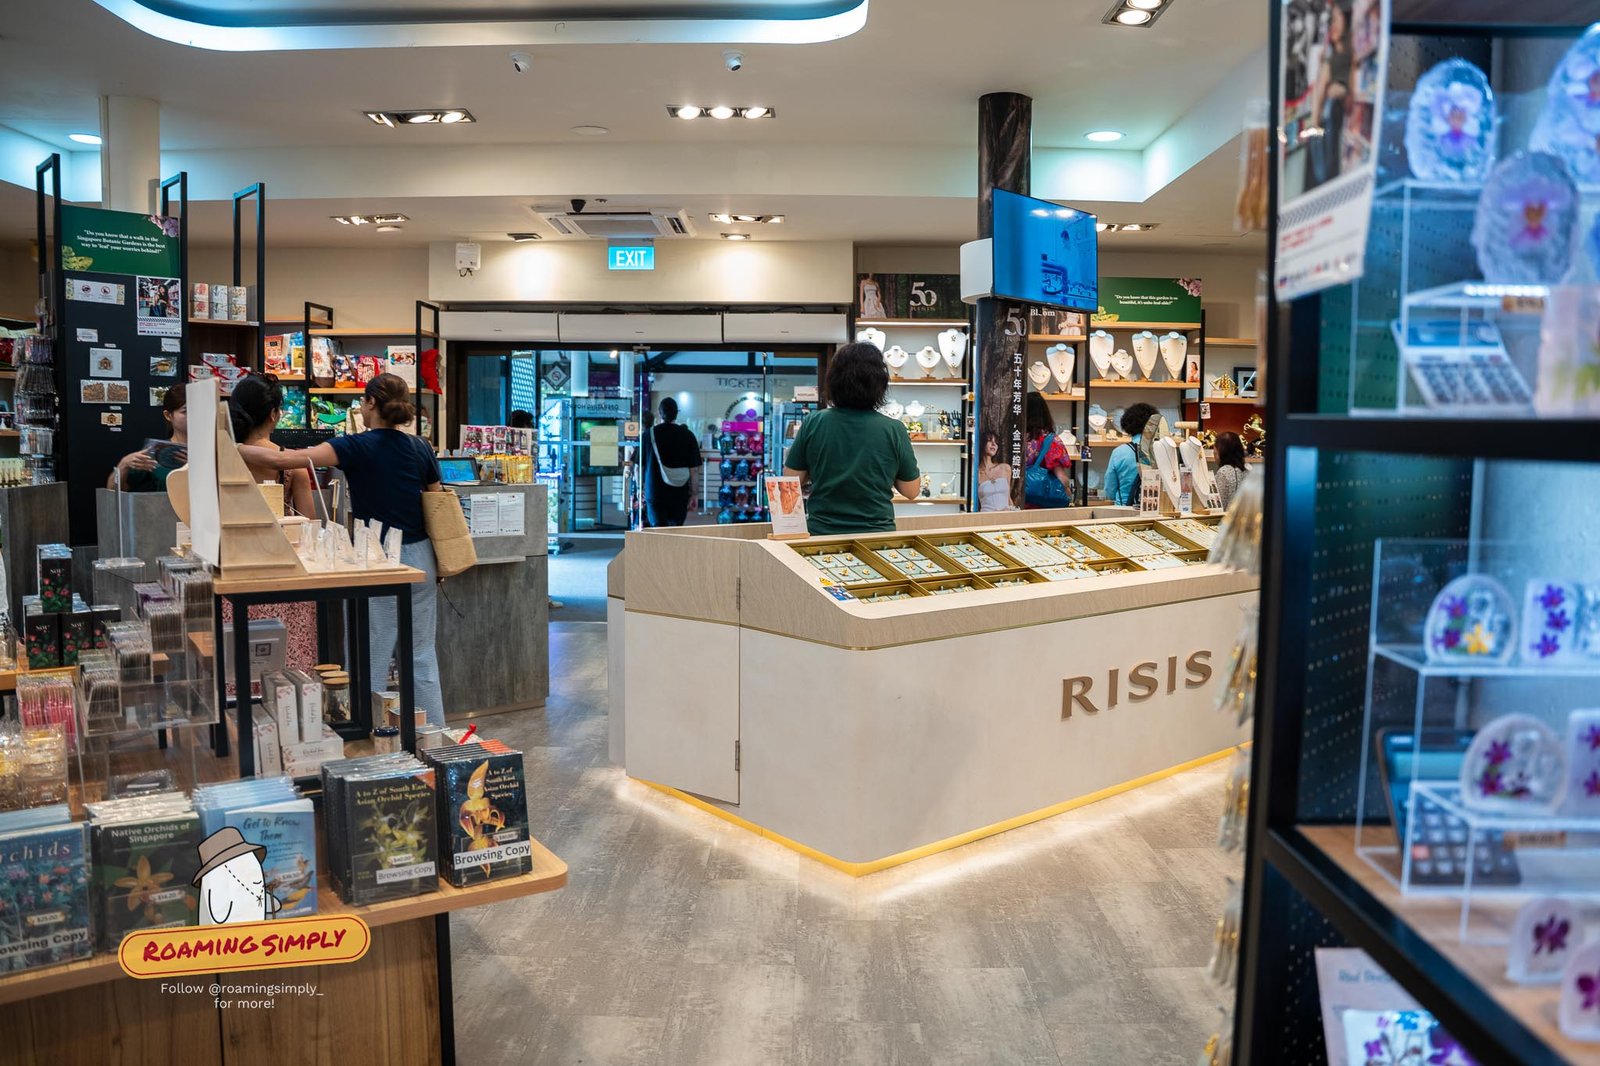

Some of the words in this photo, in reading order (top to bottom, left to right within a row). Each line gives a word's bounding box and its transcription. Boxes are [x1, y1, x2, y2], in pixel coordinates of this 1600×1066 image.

[76, 235, 102, 243] Singapore
[615, 250, 647, 267] EXIT
[910, 281, 937, 306] 50
[1004, 307, 1027, 337] 50
[1061, 650, 1213, 720] RISIS
[389, 784, 410, 793] South
[491, 792, 513, 800] Species
[357, 797, 376, 806] Asian
[377, 794, 402, 803] Orchid
[404, 791, 431, 800] Species
[243, 817, 260, 830] Get
[262, 818, 271, 827] to
[274, 816, 300, 827] Know
[111, 827, 142, 838] Native
[144, 824, 178, 834] Orchids
[129, 832, 174, 844] Singapore
[260, 830, 282, 841] Them
[0, 841, 71, 863] chids
[454, 849, 503, 865] Browsing
[505, 844, 530, 857] Copy
[378, 868, 413, 879] Browsing
[414, 864, 433, 875] Copy
[0, 939, 49, 955] owsing
[53, 930, 86, 945] Copy
